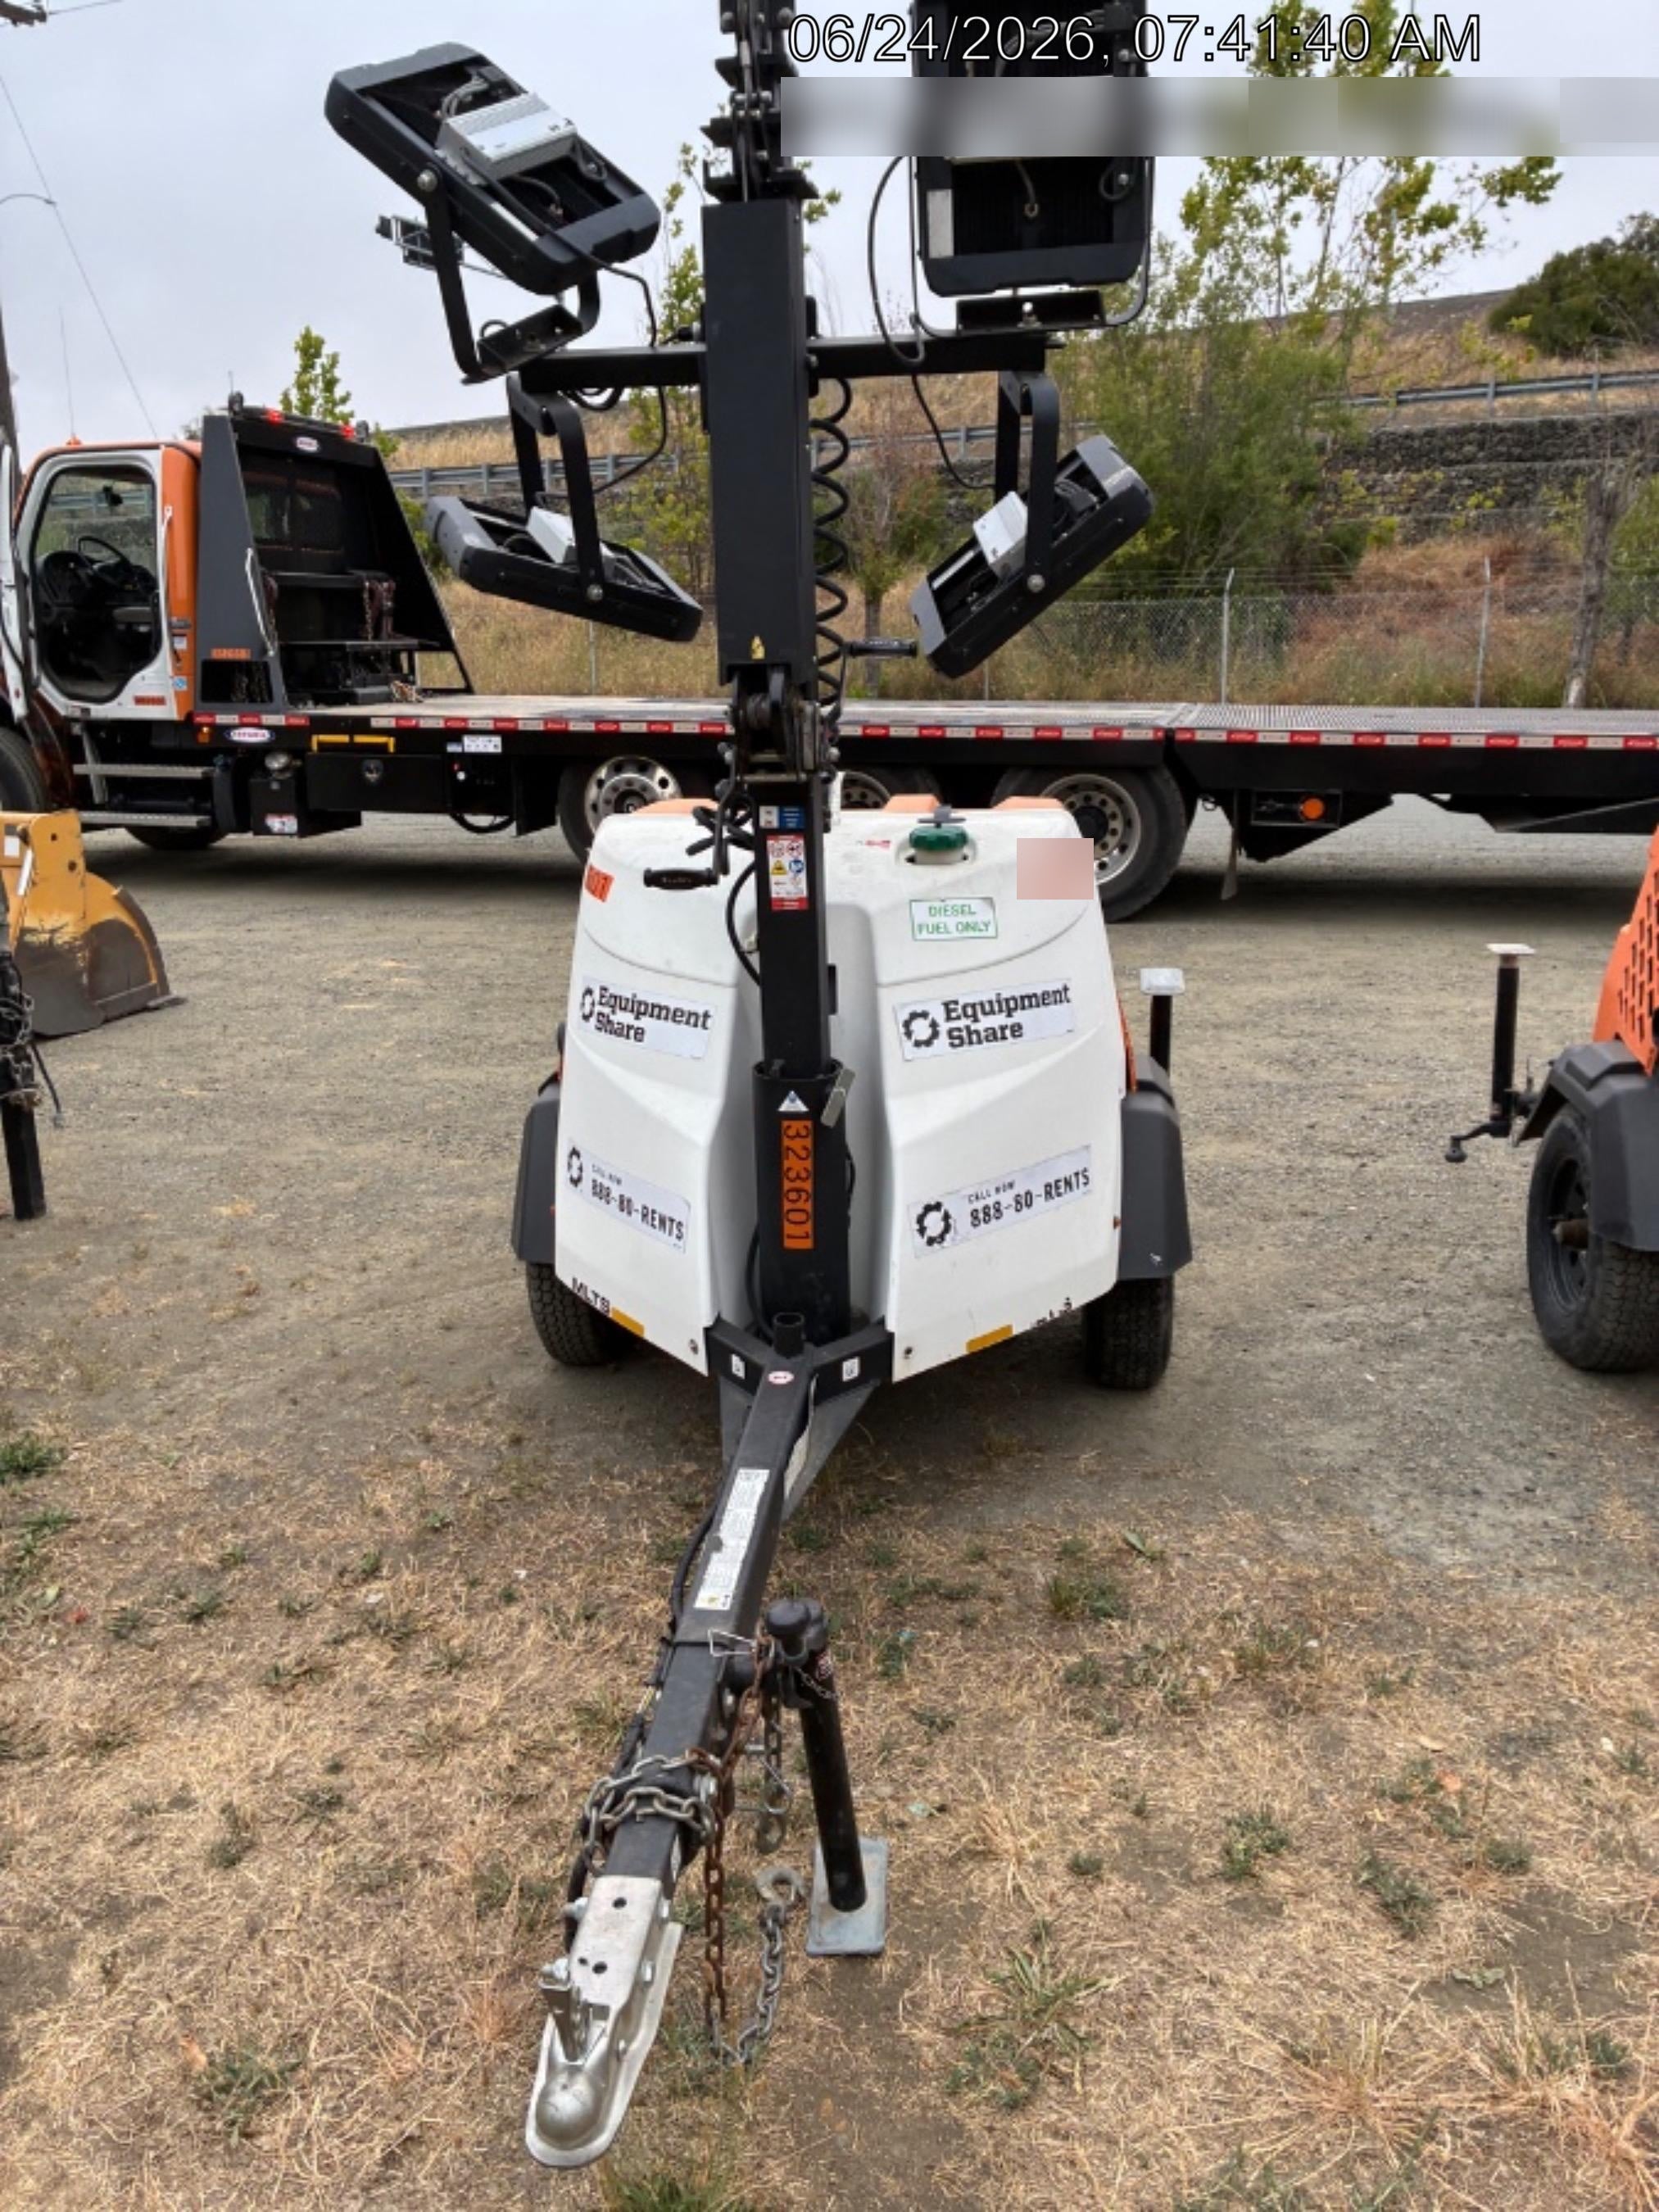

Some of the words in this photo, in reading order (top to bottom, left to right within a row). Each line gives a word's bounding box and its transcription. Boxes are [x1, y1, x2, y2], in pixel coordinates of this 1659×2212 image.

[918, 922, 951, 935] FUEL
[955, 920, 990, 932] ONLY
[928, 904, 976, 917] DIESEL
[598, 985, 711, 1030] Equipment
[941, 982, 1071, 1023] Equipment
[595, 1010, 645, 1042] Share
[946, 1021, 1023, 1048] Share
[784, 1124, 810, 1240] 323601
[968, 1190, 991, 1204] CALL
[995, 1180, 1016, 1195] NOW
[970, 1167, 1090, 1227] 888-80-RENTS
[591, 1178, 684, 1241] 888-80-RENTS
